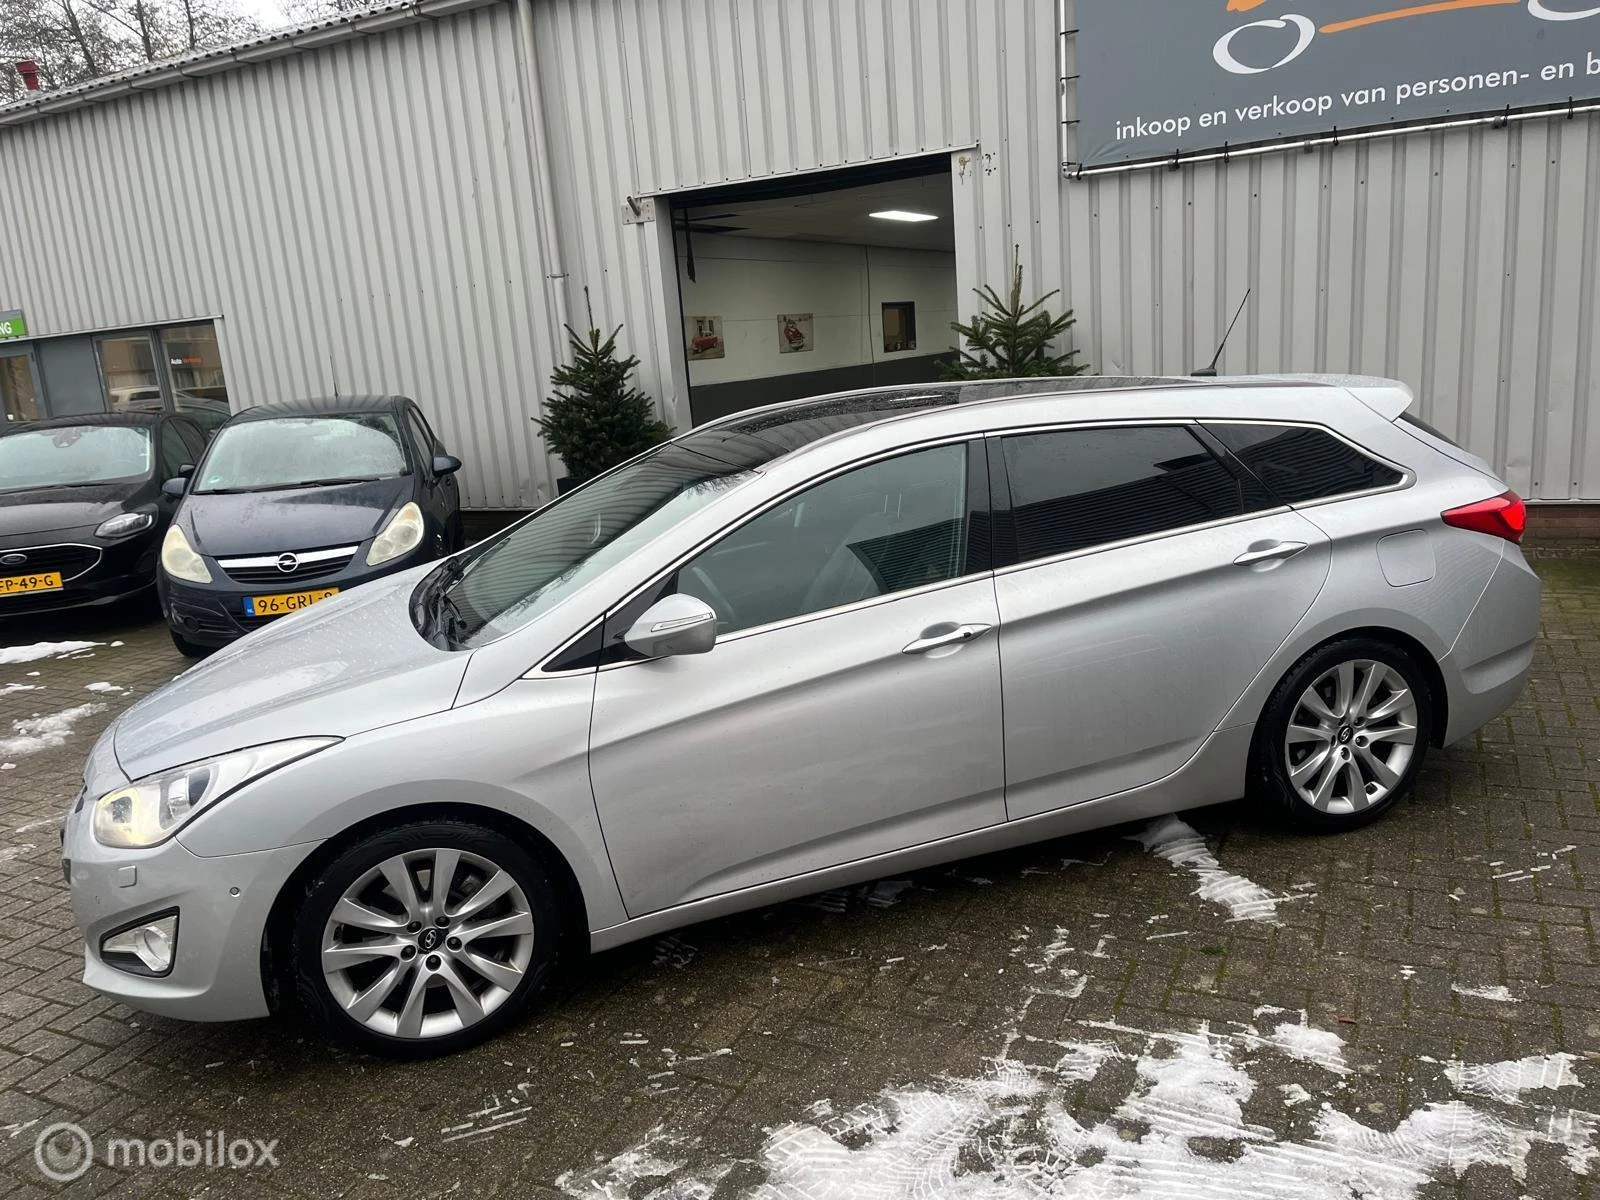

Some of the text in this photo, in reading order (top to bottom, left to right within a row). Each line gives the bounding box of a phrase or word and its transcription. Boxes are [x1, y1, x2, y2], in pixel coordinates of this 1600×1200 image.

[1115, 115, 1191, 140] inkoop
[1199, 109, 1227, 128] en
[1235, 95, 1333, 122] verkoop
[1341, 86, 1386, 108] van
[1396, 69, 1530, 105] personen-
[1540, 62, 1574, 81] en
